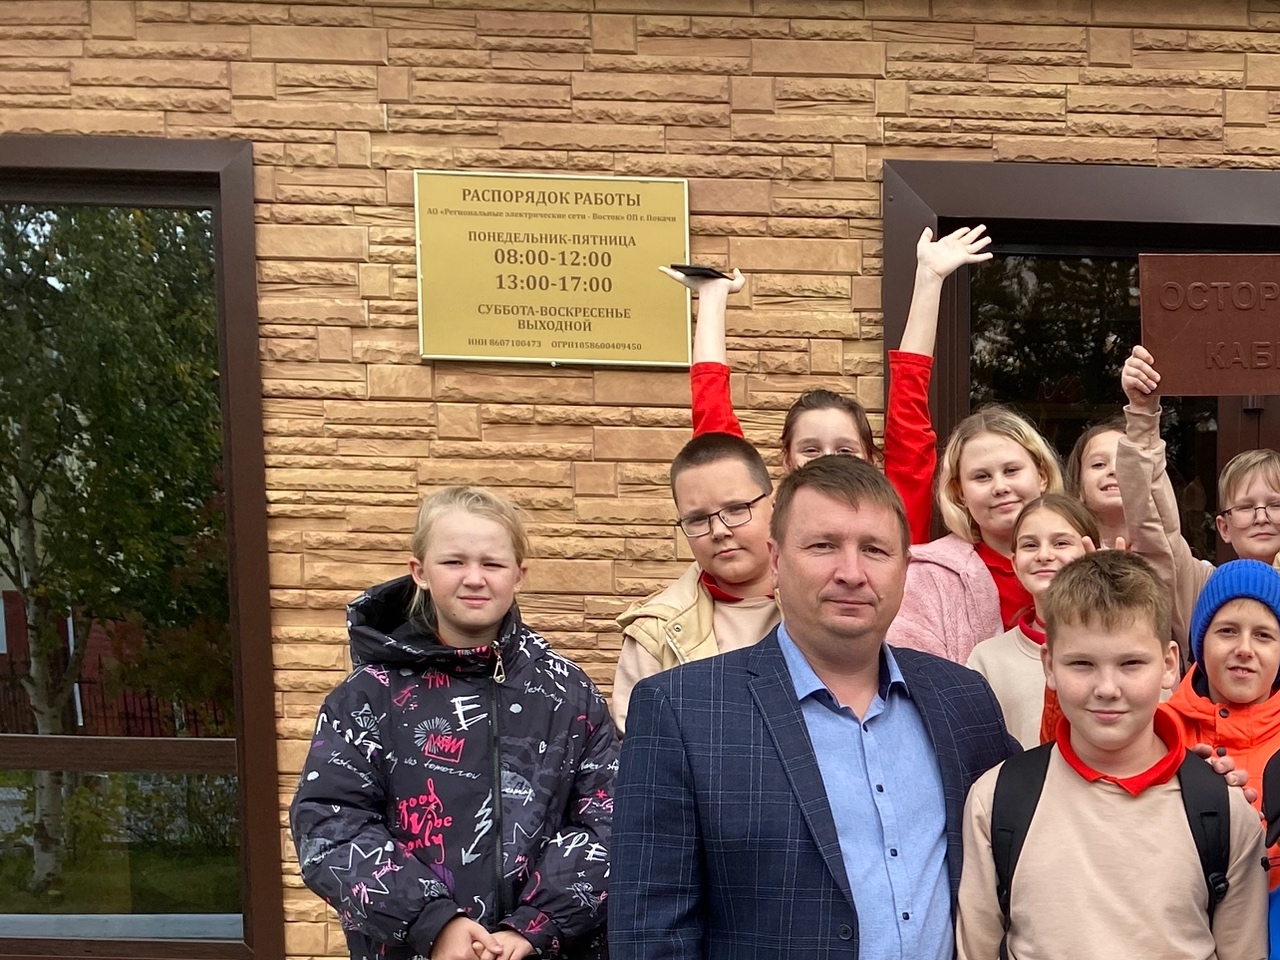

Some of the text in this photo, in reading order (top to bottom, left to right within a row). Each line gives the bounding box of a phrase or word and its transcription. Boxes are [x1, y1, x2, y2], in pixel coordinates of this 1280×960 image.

[461, 188, 641, 207] РАСПОРЯДОК РАБОТЫ
[426, 207, 439, 215] АО
[440, 208, 503, 217] «Региональные
[505, 211, 567, 220] электрические
[592, 213, 625, 221] Восток»
[646, 214, 677, 222] Покачи
[468, 230, 637, 248] ПОНЕДЕЛЬНИК-ПЯТНИЦА
[493, 248, 612, 267] 08:00-12:00
[495, 274, 613, 293] 13:00-17:00
[477, 303, 632, 319] СУББОТА-ВОСКРЕСЕНЬЕ
[517, 318, 592, 333] ВЫХОДНОЙ
[467, 337, 488, 346] ИНН
[489, 339, 542, 348] 8607100473
[398, 778, 444, 830] good
[407, 822, 446, 865] only
